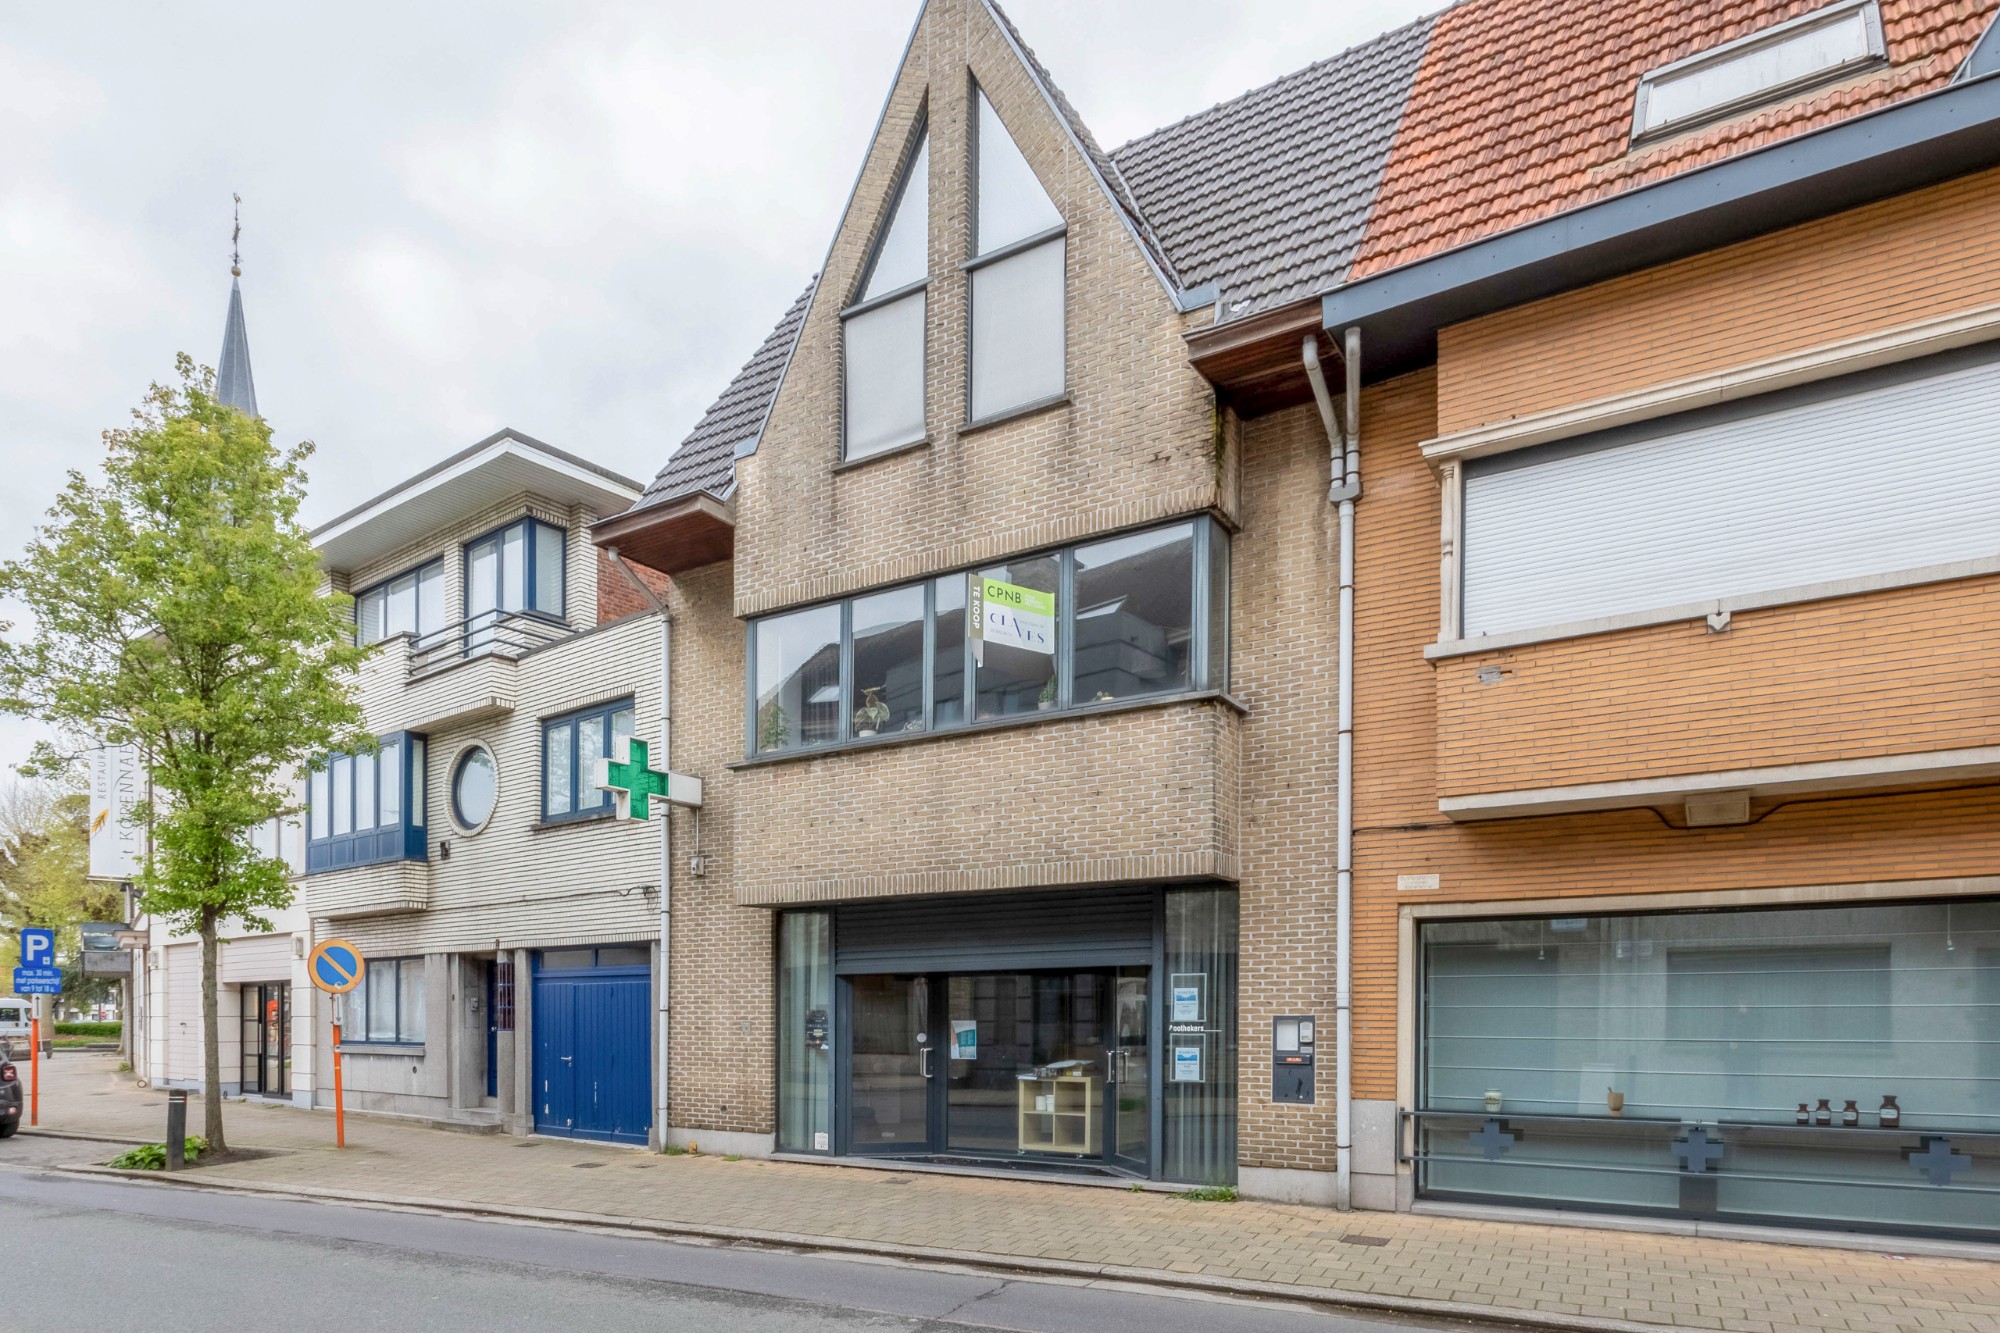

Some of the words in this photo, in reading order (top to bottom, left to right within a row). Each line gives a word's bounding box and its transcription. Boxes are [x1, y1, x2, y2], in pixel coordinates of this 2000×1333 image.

[973, 586, 981, 598] TE
[987, 585, 1022, 604] CPNB
[973, 600, 981, 629] KOOP
[119, 736, 134, 841] KORENNAE
[27, 935, 49, 961] P
